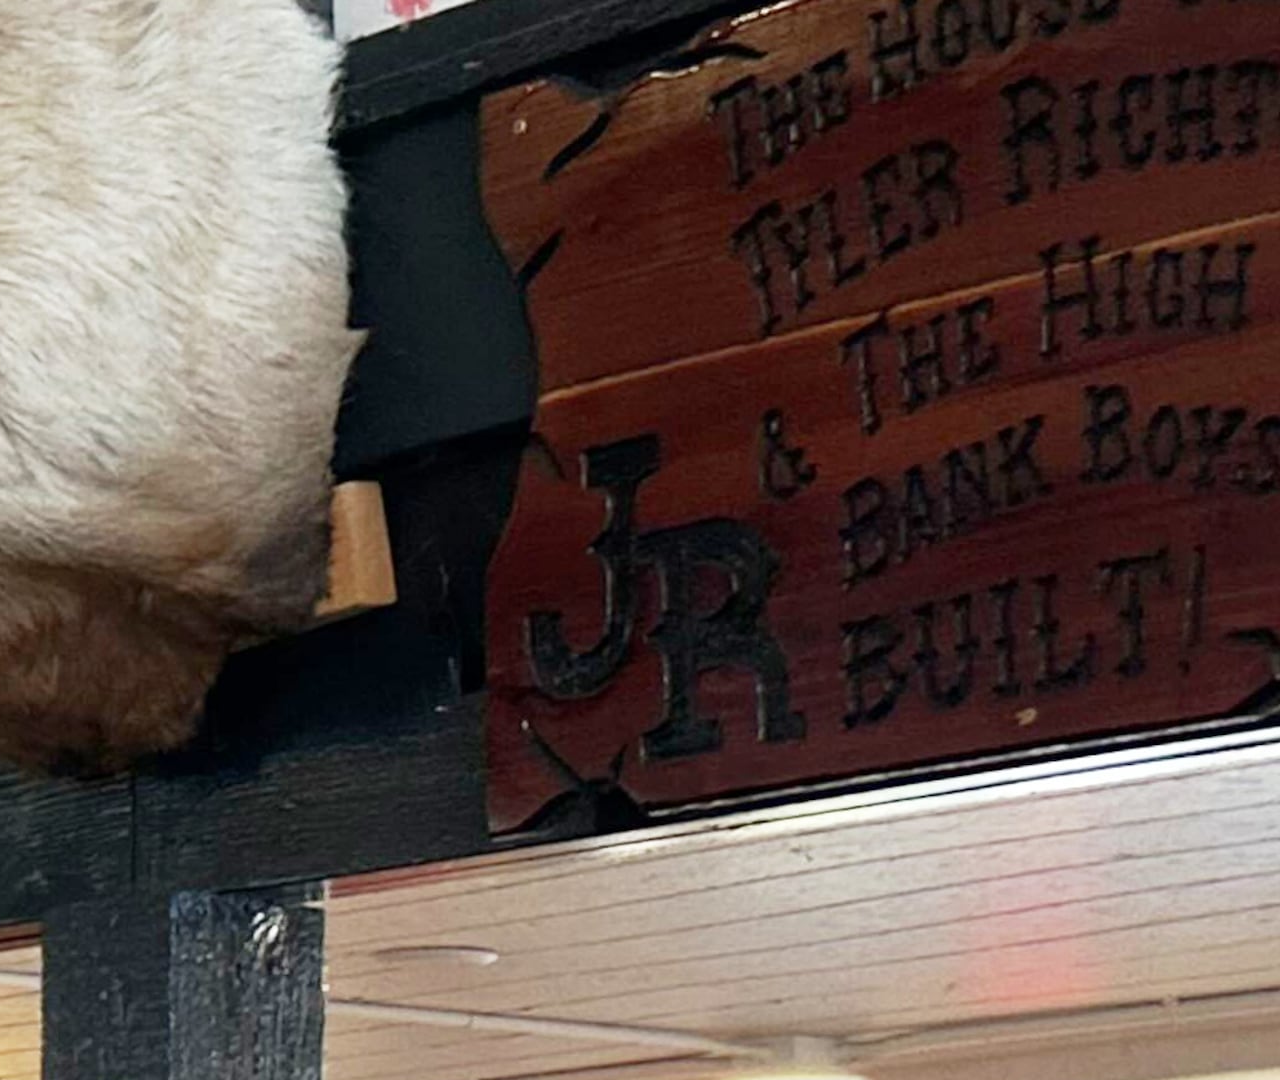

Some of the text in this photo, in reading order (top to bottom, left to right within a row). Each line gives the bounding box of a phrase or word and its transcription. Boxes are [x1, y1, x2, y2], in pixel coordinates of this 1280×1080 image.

[708, 51, 853, 191] THE
[729, 137, 965, 338] TYLER
[838, 233, 1256, 436] THE HIGH
[757, 383, 1280, 588] & BANK BOYS
